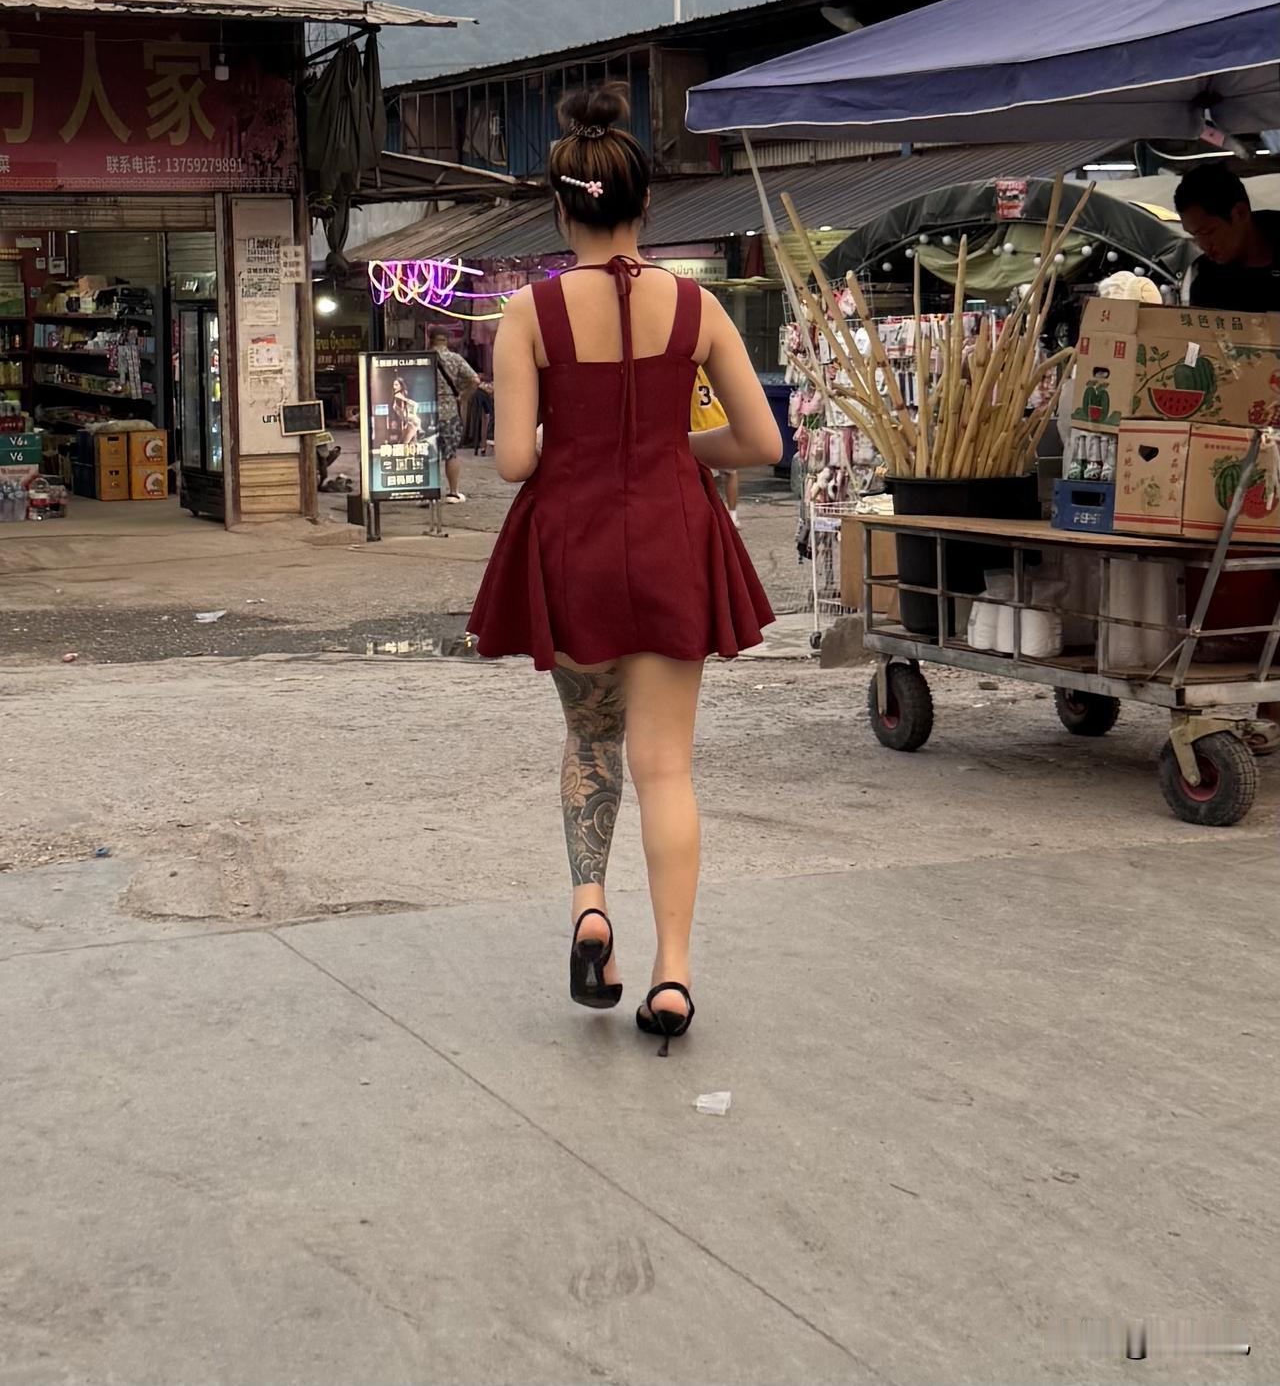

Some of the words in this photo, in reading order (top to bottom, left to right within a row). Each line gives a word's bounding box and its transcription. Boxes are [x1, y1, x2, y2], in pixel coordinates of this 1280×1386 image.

[166, 157, 243, 173] 13759279891
[698, 385, 712, 406] 3
[9, 452, 24, 462] V6
